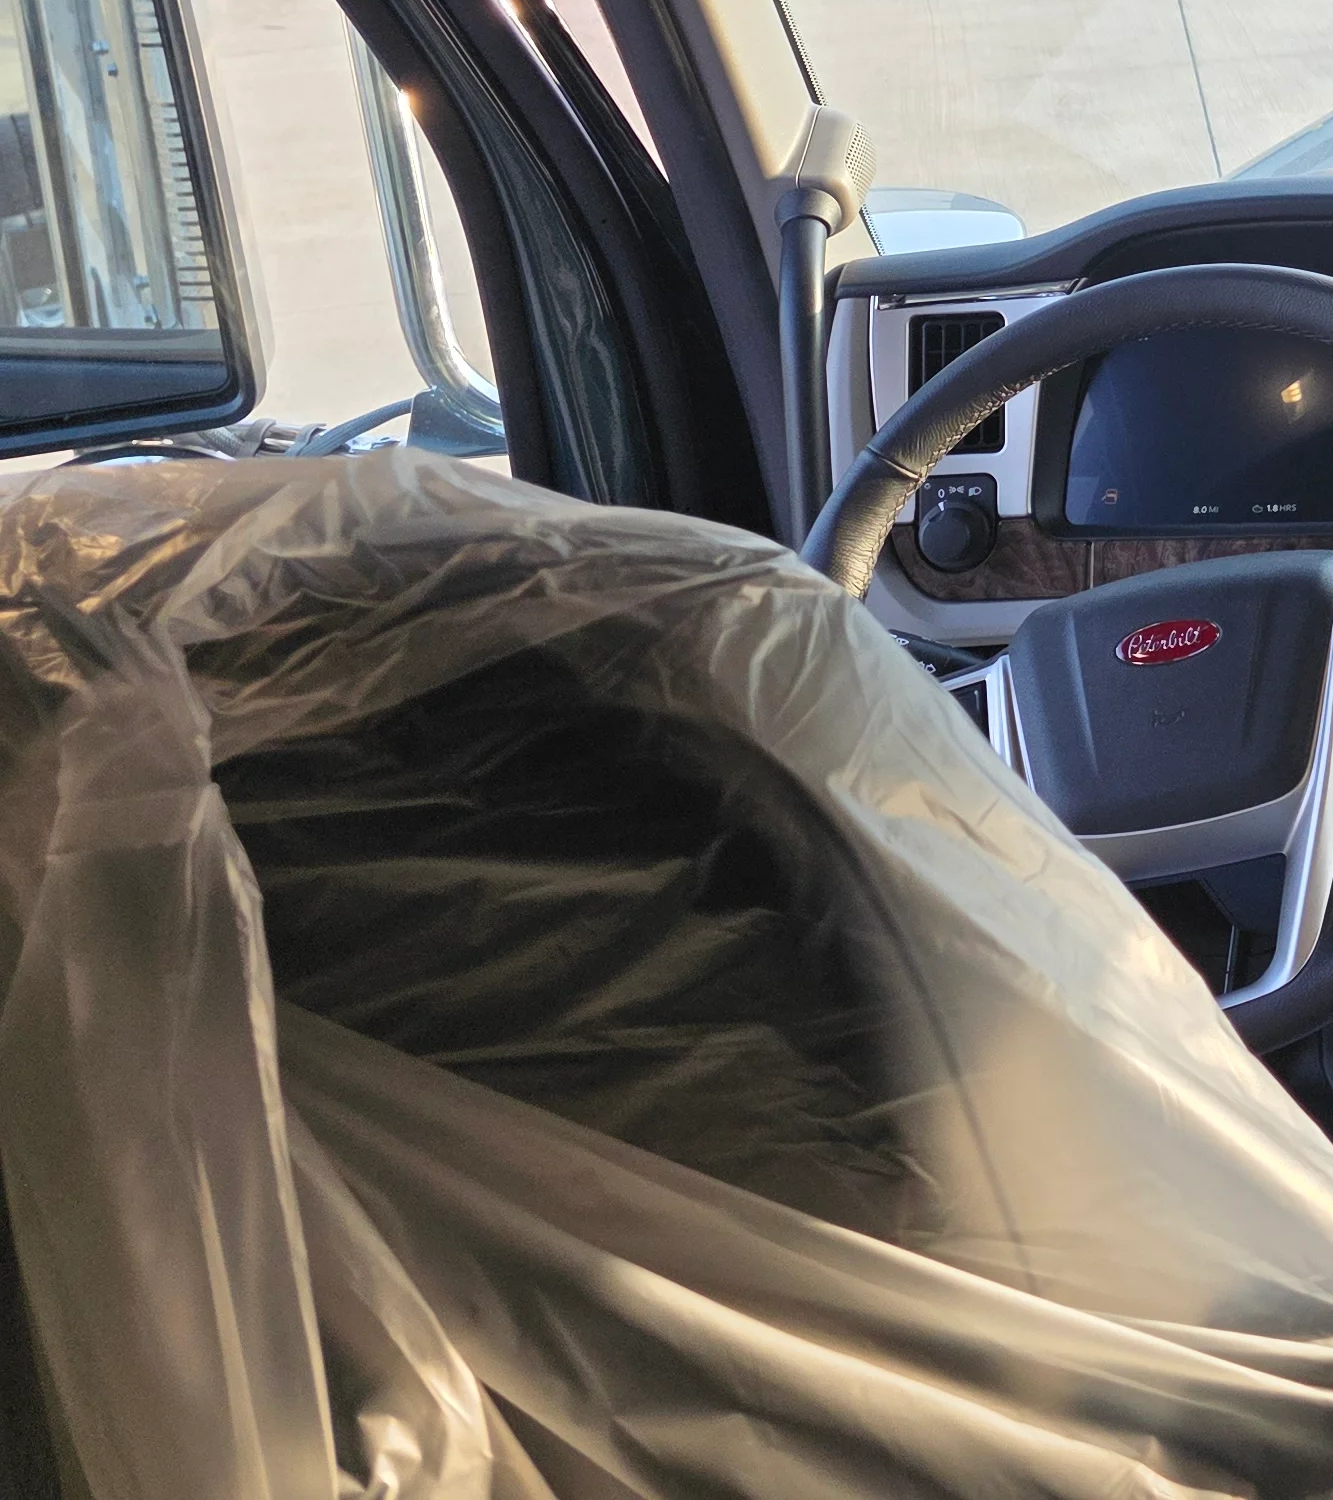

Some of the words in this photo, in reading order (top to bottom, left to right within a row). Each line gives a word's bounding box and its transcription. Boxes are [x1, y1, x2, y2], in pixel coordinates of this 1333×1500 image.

[1192, 505, 1208, 514] 8.0
[1266, 504, 1279, 513] 1.8
[1279, 503, 1297, 512] HRS
[1127, 625, 1209, 659] Peterbilt
